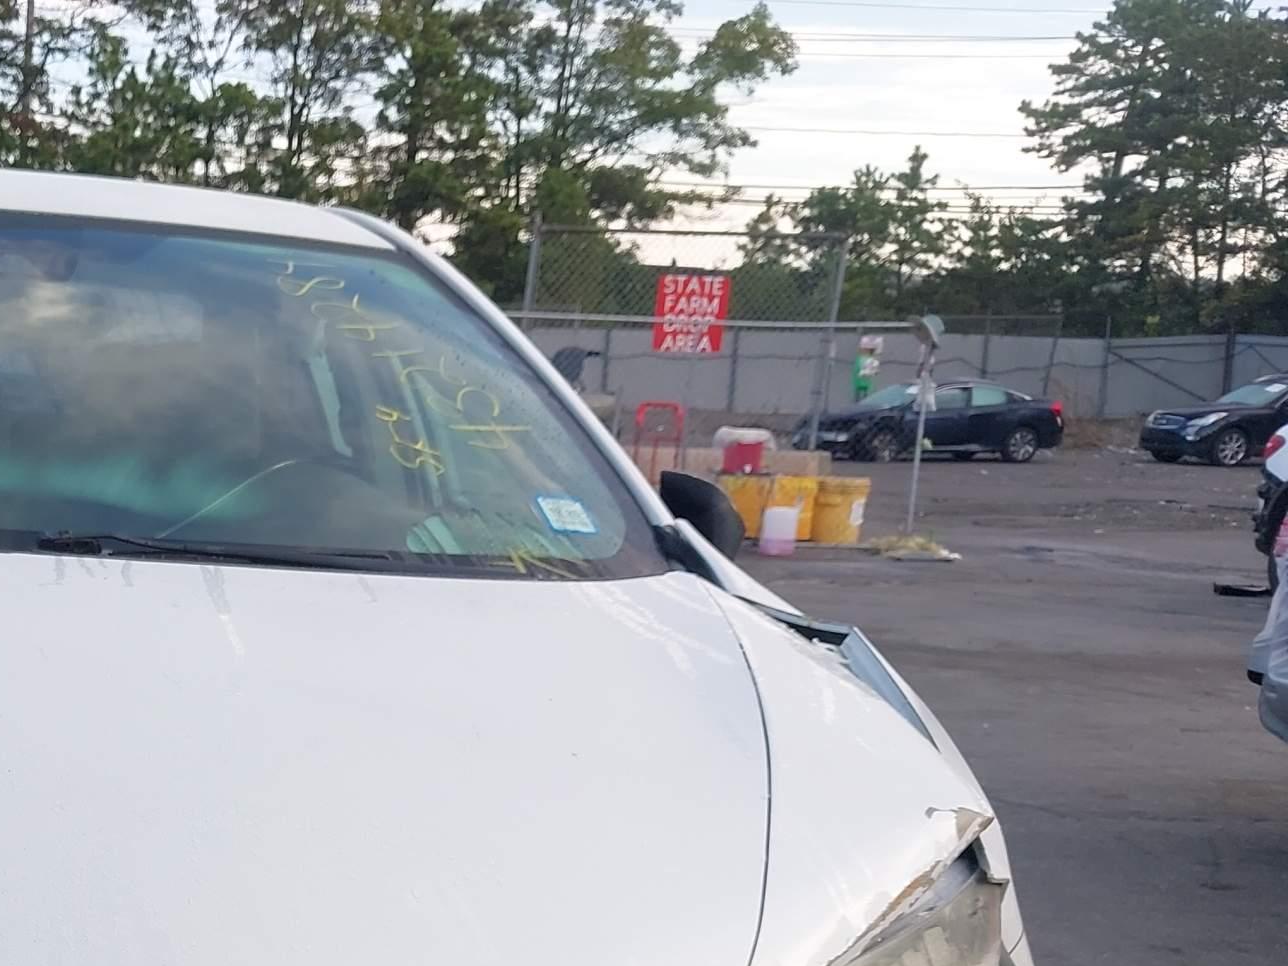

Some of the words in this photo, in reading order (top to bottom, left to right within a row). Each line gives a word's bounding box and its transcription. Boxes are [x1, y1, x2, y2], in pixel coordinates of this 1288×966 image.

[663, 274, 725, 295] STATE
[663, 295, 721, 314] FARM
[660, 333, 713, 353] AREA
